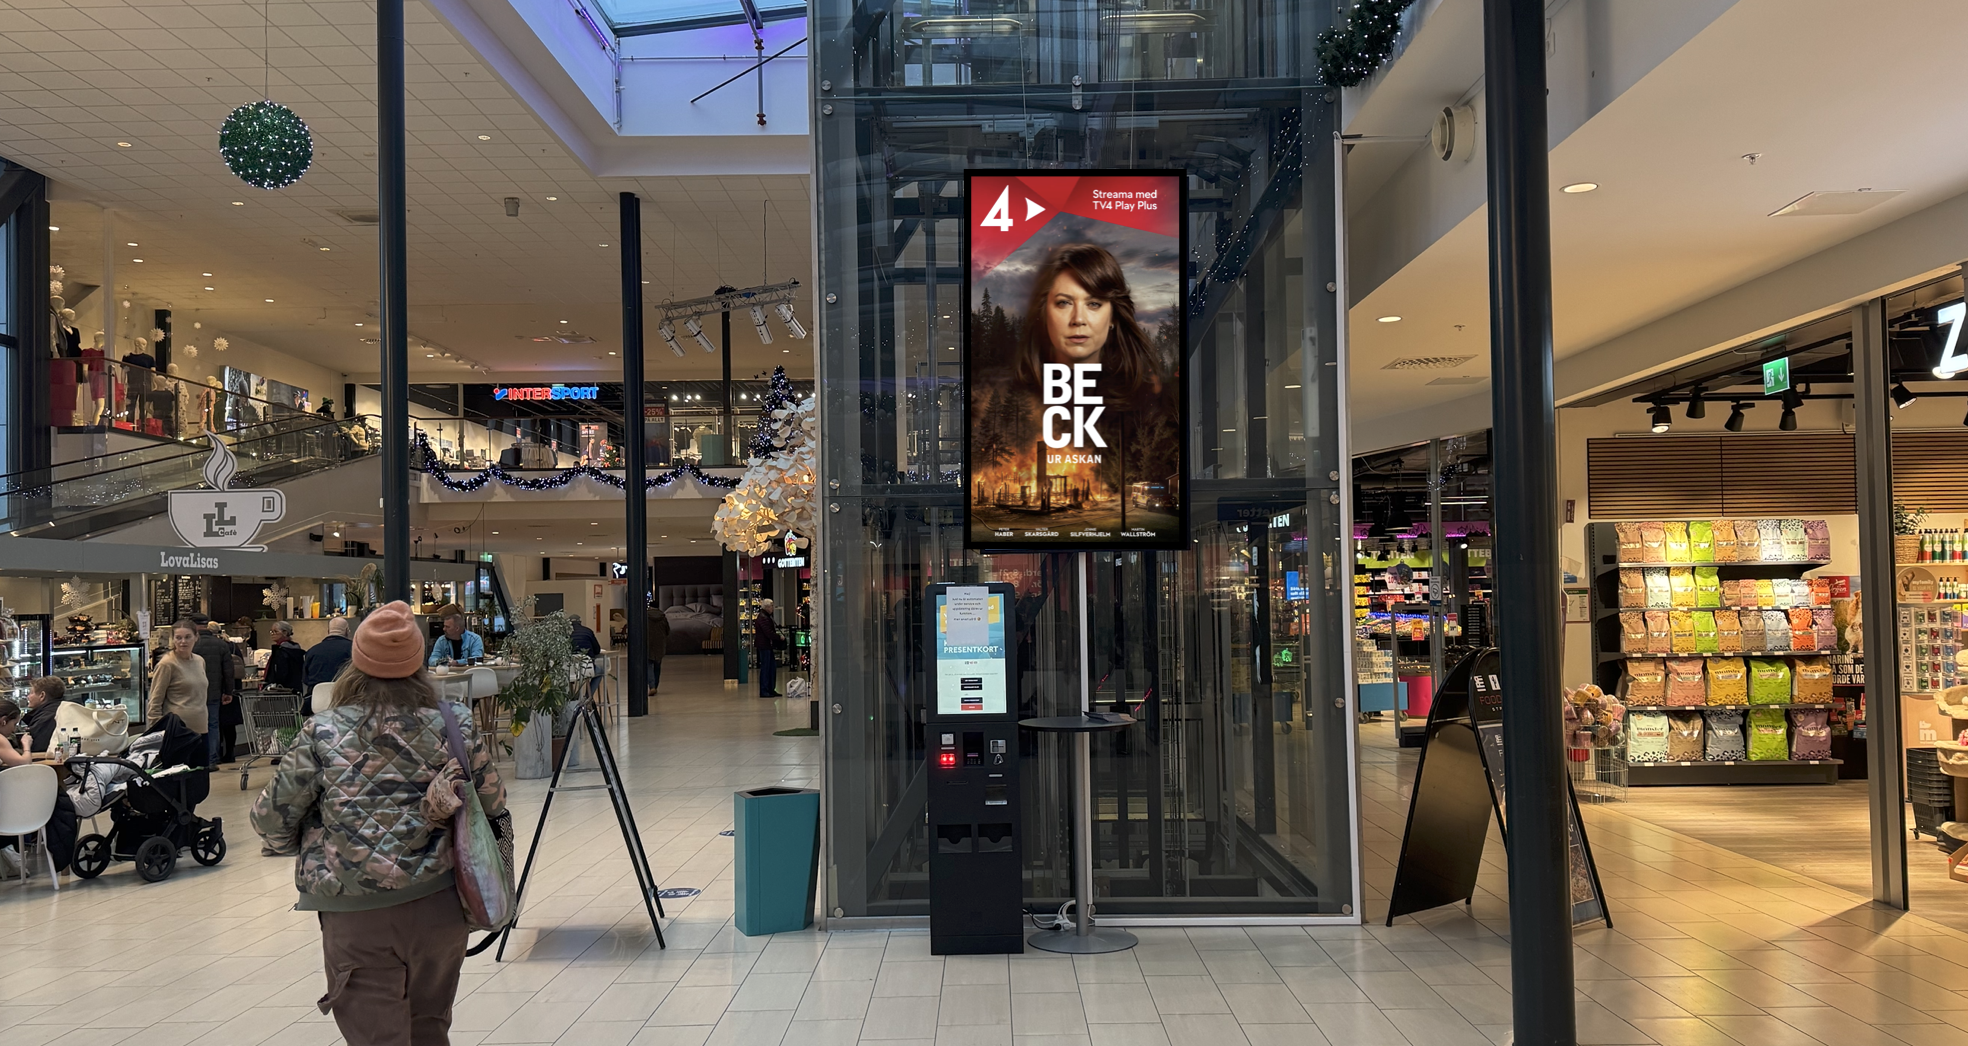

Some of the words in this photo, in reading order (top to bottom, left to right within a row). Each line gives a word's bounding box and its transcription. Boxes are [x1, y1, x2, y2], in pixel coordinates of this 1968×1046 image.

[1093, 190, 1133, 199] Streama
[1135, 190, 1157, 199] med
[980, 185, 1013, 231] 4
[1093, 201, 1113, 210] TV4
[1115, 201, 1135, 212] Play
[1137, 201, 1157, 210] Plus
[1938, 302, 1968, 374] Z
[1043, 363, 1103, 405] BE
[508, 387, 599, 400] INTERSPORT
[1042, 406, 1108, 449] CK
[1047, 455, 1062, 464] UR
[1064, 455, 1102, 464] ASKAN
[160, 552, 219, 569] LovaLisas
[943, 645, 998, 654] PRESENTKORT
[1838, 664, 1854, 674] SOM
